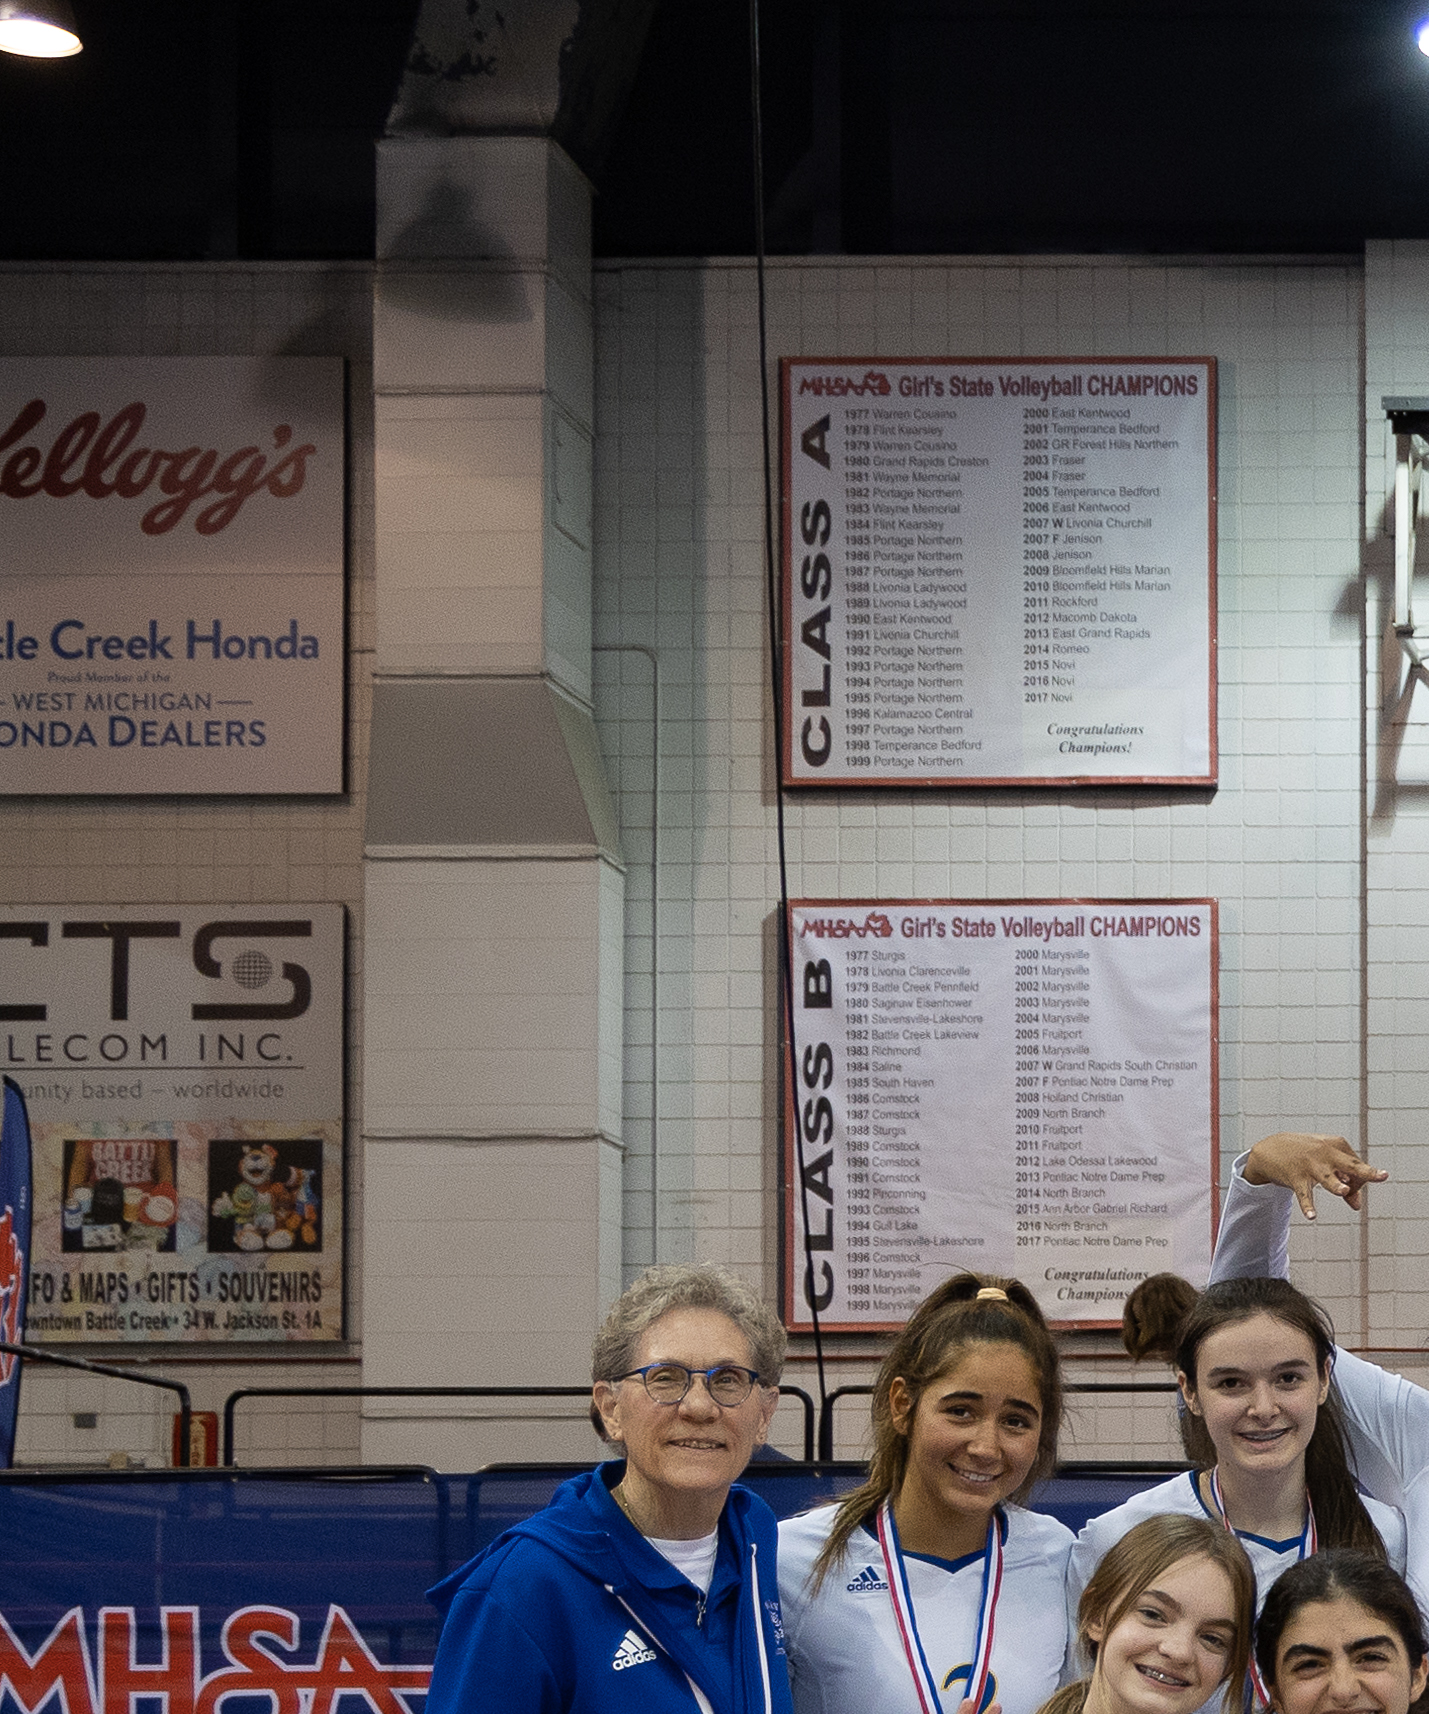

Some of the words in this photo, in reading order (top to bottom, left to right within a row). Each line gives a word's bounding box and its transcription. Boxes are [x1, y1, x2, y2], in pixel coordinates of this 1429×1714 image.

[900, 376, 947, 397] Girl's
[950, 376, 994, 397] State
[999, 376, 1082, 401] Volleyball
[1087, 374, 1198, 397] CHAMPIONS
[802, 414, 831, 470] A
[50, 619, 174, 660] Creek
[186, 619, 320, 660] Honda
[801, 499, 831, 768] CLASS
[11, 692, 77, 712] WEST
[84, 692, 212, 712] MICHIGAN
[0, 720, 98, 748] ONDA
[108, 715, 267, 748] DEALERS
[1046, 723, 1144, 738] Congratulations
[1058, 741, 1133, 756] Champions!
[900, 916, 947, 939] Girl's
[952, 916, 996, 938] State
[1001, 916, 1085, 942] Volleyball
[1090, 915, 1201, 938] CHAMPIONS
[0, 920, 313, 1021] CTS
[803, 958, 833, 1009] B
[7, 1033, 167, 1062] LECOM
[199, 1032, 293, 1062] INC.
[24, 1082, 72, 1103] unity
[82, 1079, 142, 1099] based
[173, 1079, 284, 1099] worldwide
[803, 1041, 834, 1312] CLASS
[80, 1271, 129, 1303] MAPS
[148, 1271, 199, 1302] GIFTS
[218, 1271, 322, 1303] SOUVENIRS
[1044, 1267, 1149, 1283] Congratulations
[1056, 1287, 1134, 1303] Champions
[25, 1313, 81, 1330] owntown
[86, 1311, 125, 1330] Battle
[222, 1310, 279, 1330] Jackson
[846, 1580, 890, 1593] adidas
[612, 1650, 657, 1672] adidas
